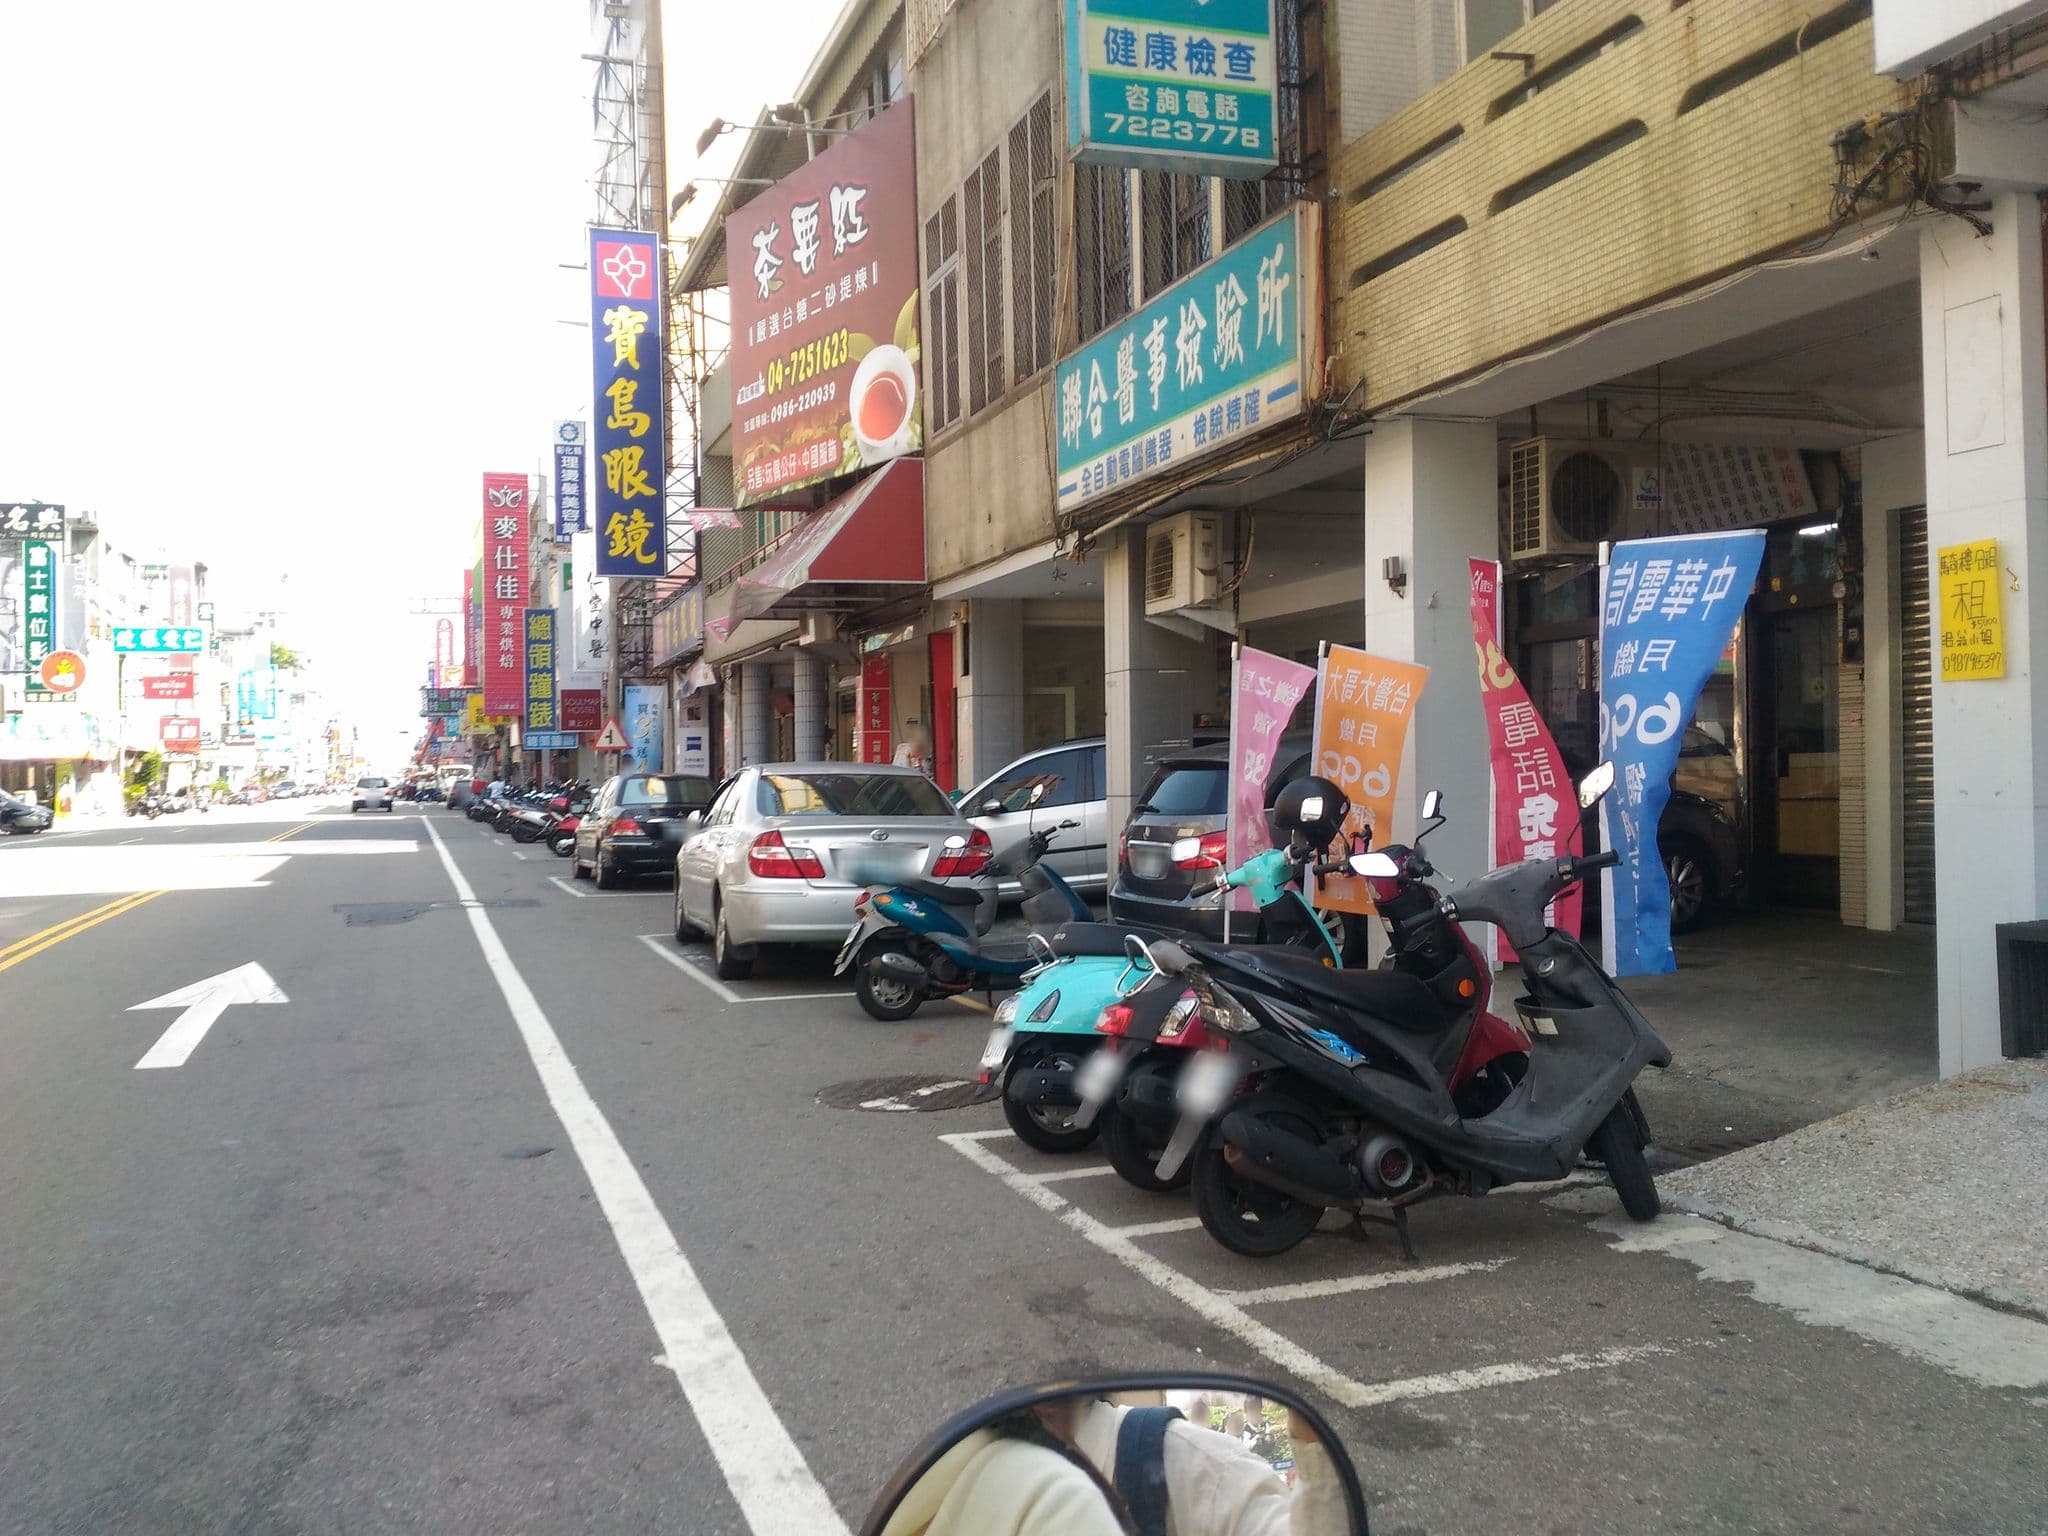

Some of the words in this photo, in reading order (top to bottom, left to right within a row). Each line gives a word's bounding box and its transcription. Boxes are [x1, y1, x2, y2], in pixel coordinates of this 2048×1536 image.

[1104, 26, 1256, 82] 健康檢查
[1104, 112, 1259, 148] 7223778
[767, 327, 848, 396] 04-7251623
[1062, 243, 1289, 449] 聯合醫事檢驗所
[770, 381, 835, 423] 0986-220939
[602, 304, 657, 564] 寶島眼鏡
[0, 506, 63, 532] 名典
[494, 515, 519, 600] 麥仕佳
[1951, 580, 1987, 623] 租
